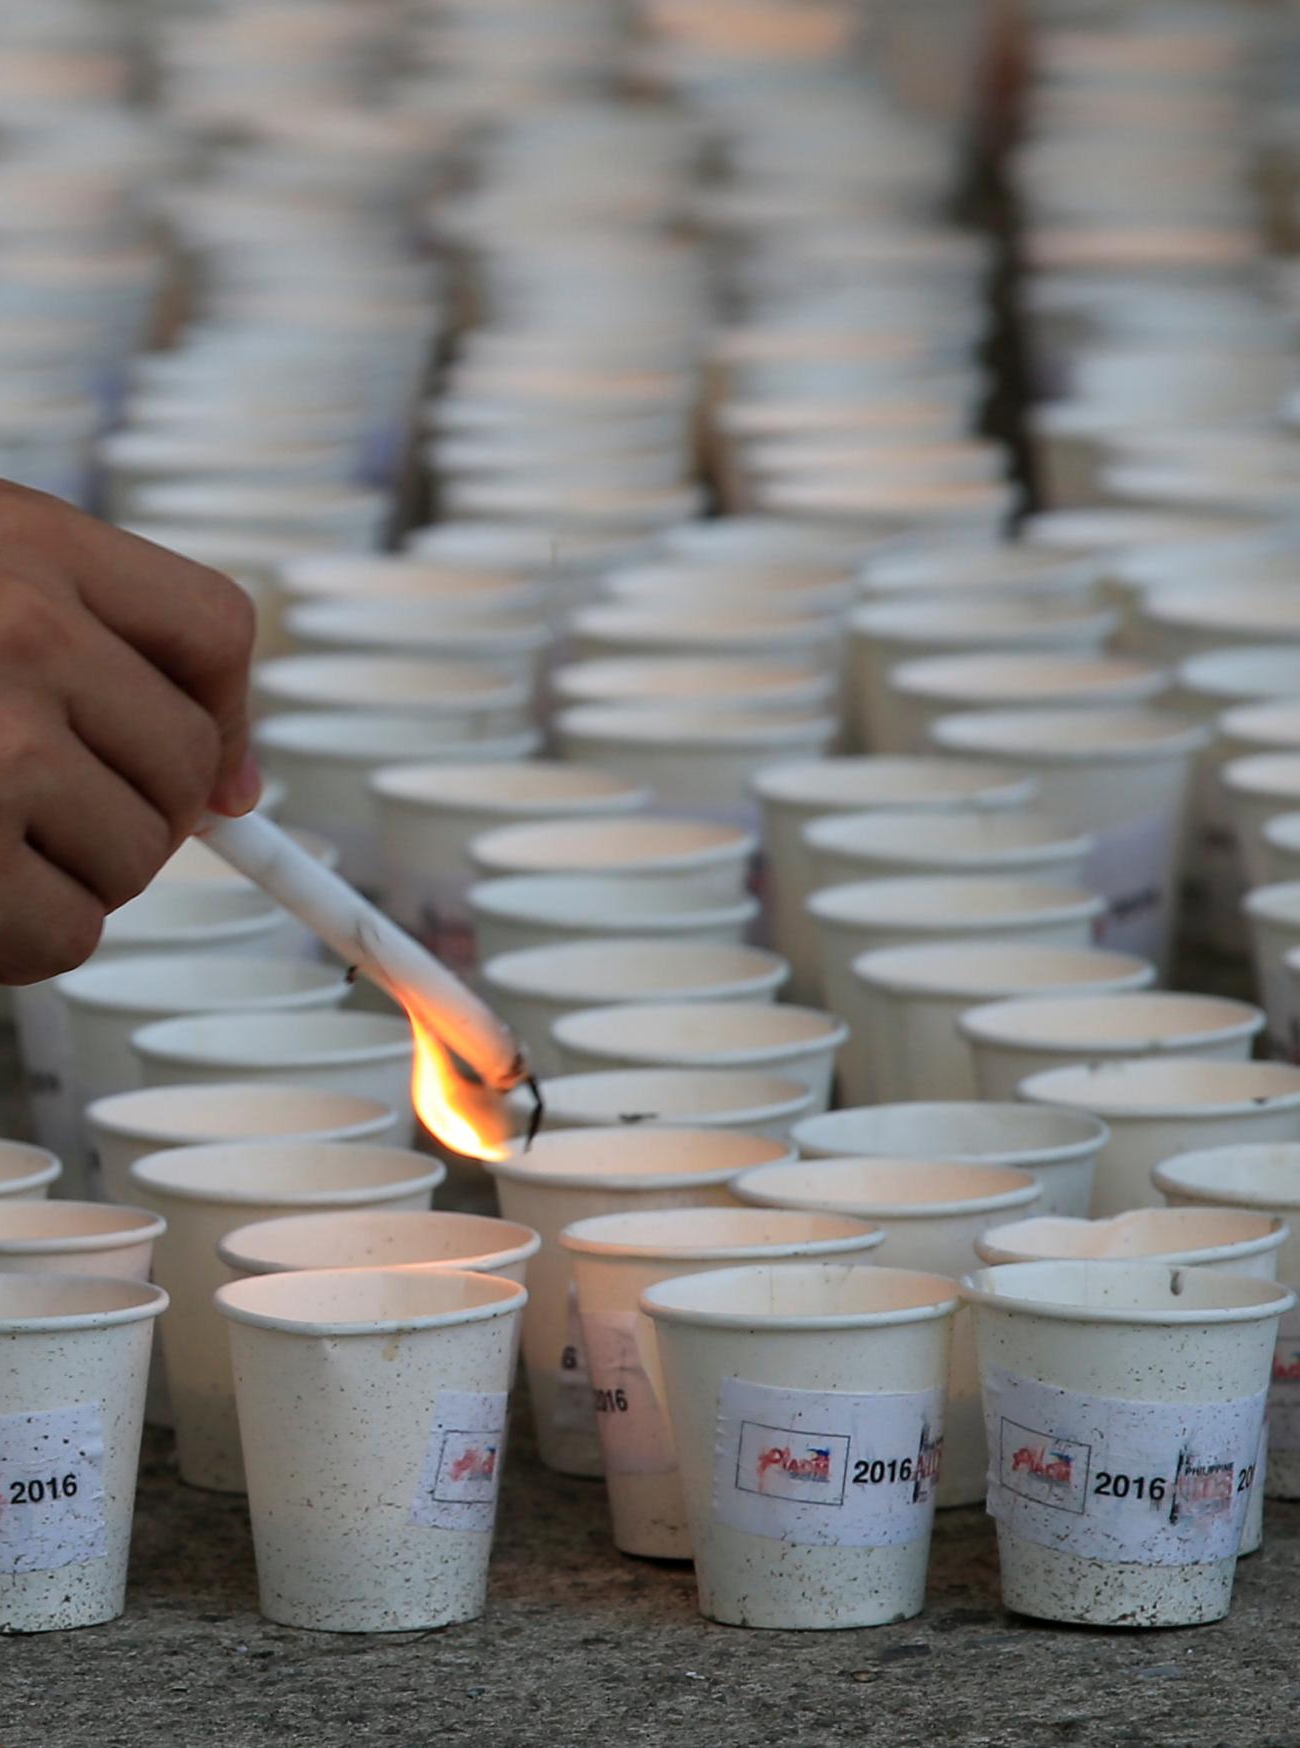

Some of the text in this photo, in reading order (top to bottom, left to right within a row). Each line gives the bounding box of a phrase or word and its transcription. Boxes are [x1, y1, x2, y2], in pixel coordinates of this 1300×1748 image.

[851, 1457, 912, 1484] 2016
[9, 1474, 78, 1505] 2016
[1093, 1471, 1166, 1501] 2016
